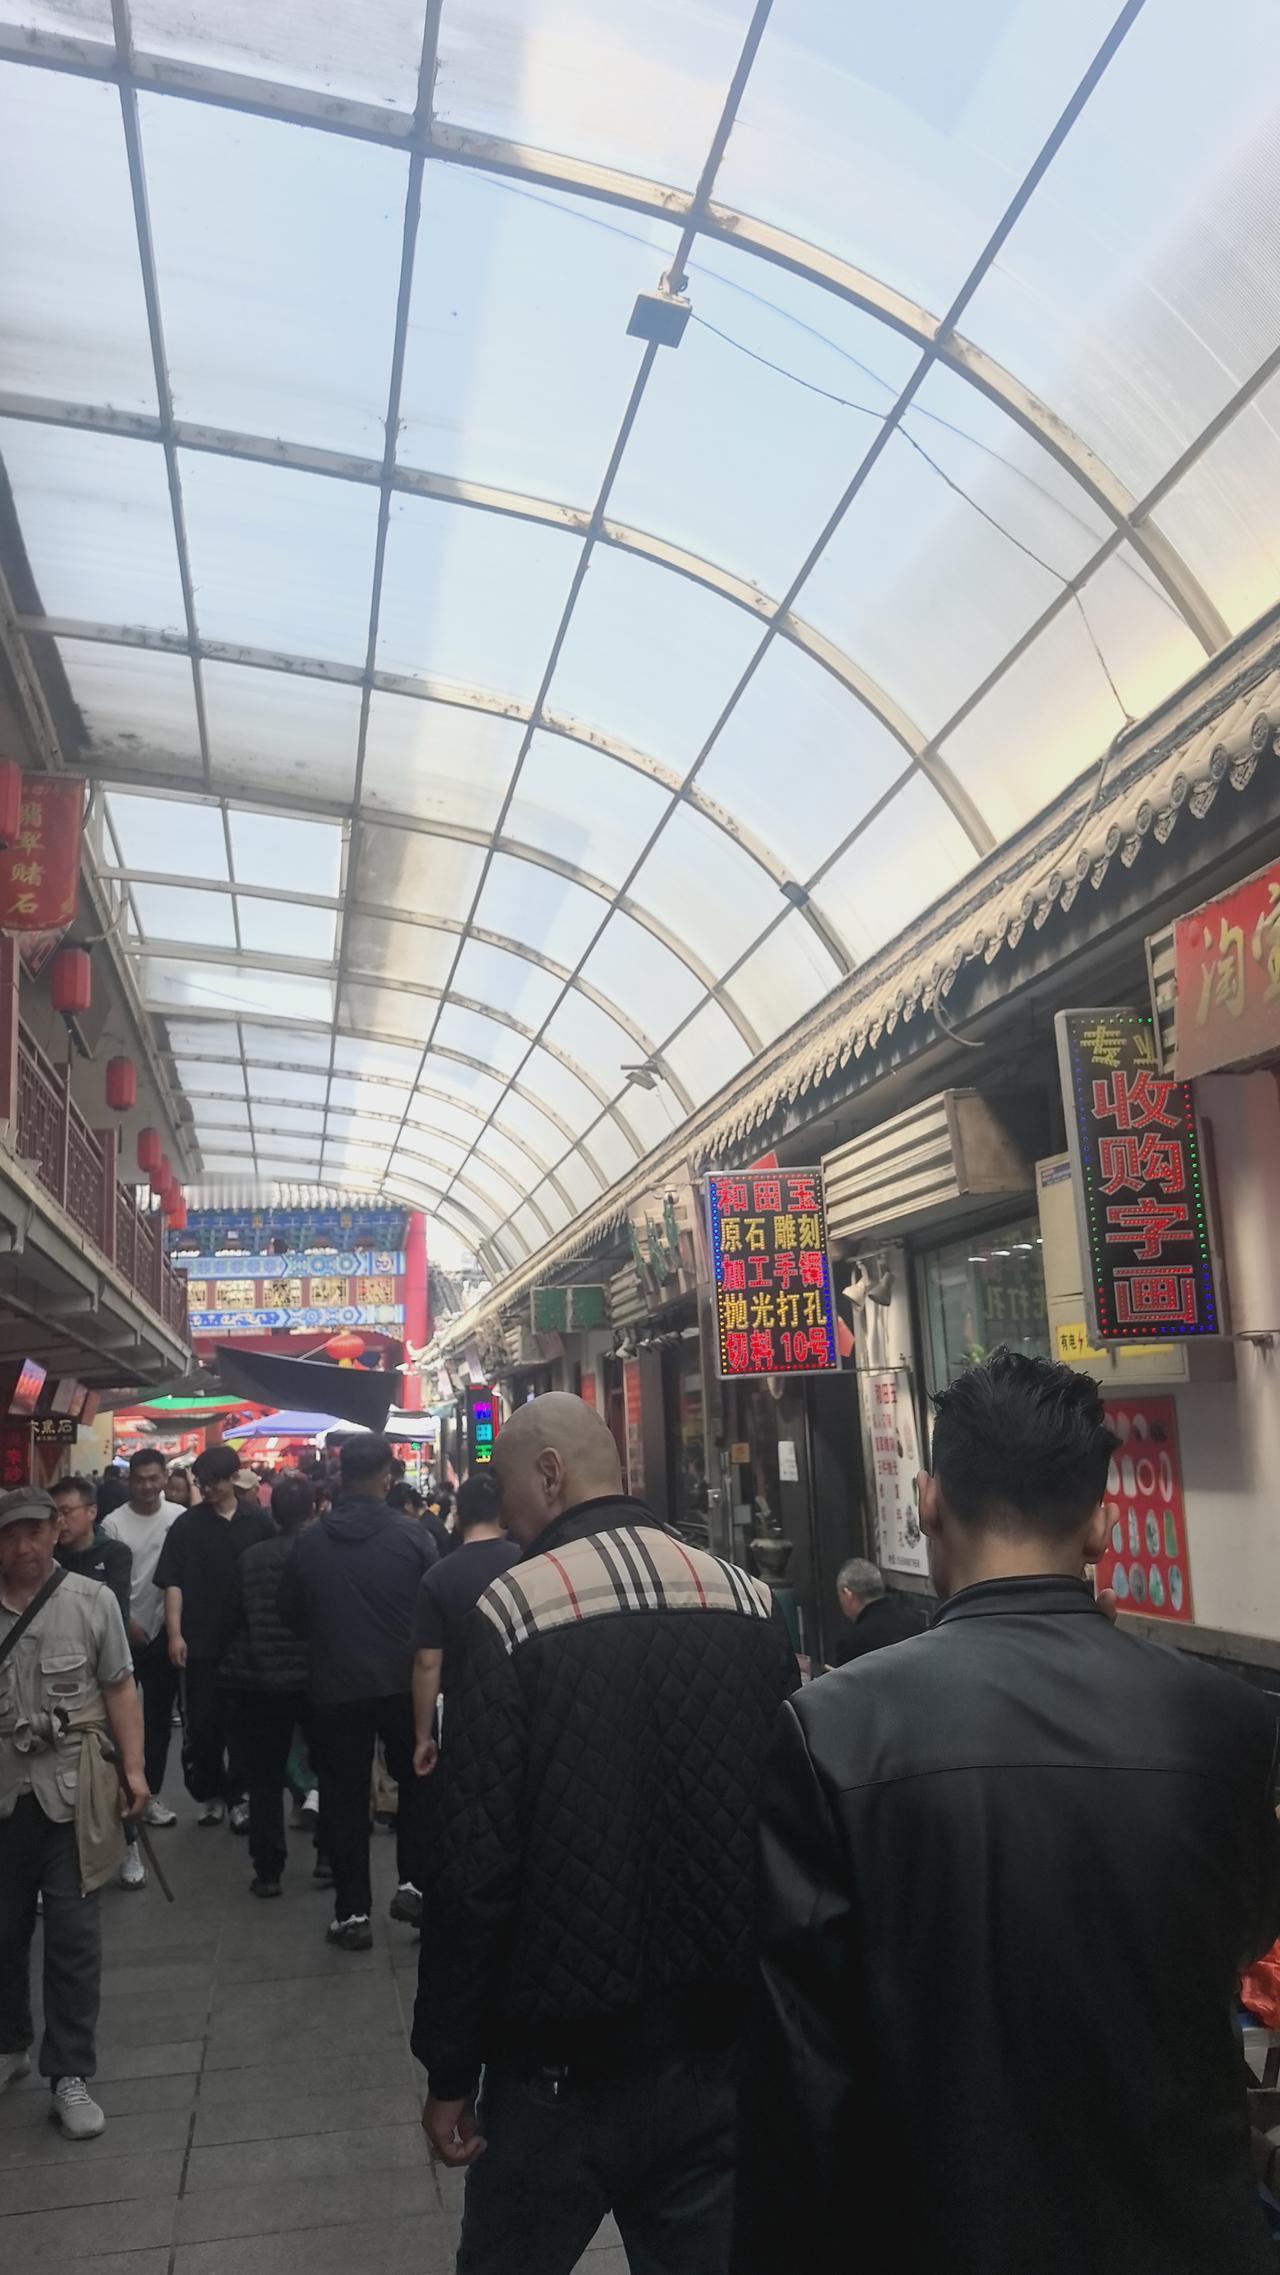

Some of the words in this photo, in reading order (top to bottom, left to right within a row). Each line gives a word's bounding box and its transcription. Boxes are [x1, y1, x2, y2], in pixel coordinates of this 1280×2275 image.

[716, 1179, 820, 1216] 和田玉
[1090, 1070, 1197, 1325] 收购字画
[721, 1250, 825, 1291] 加工手镯
[723, 1289, 828, 1330] 抛光打孔
